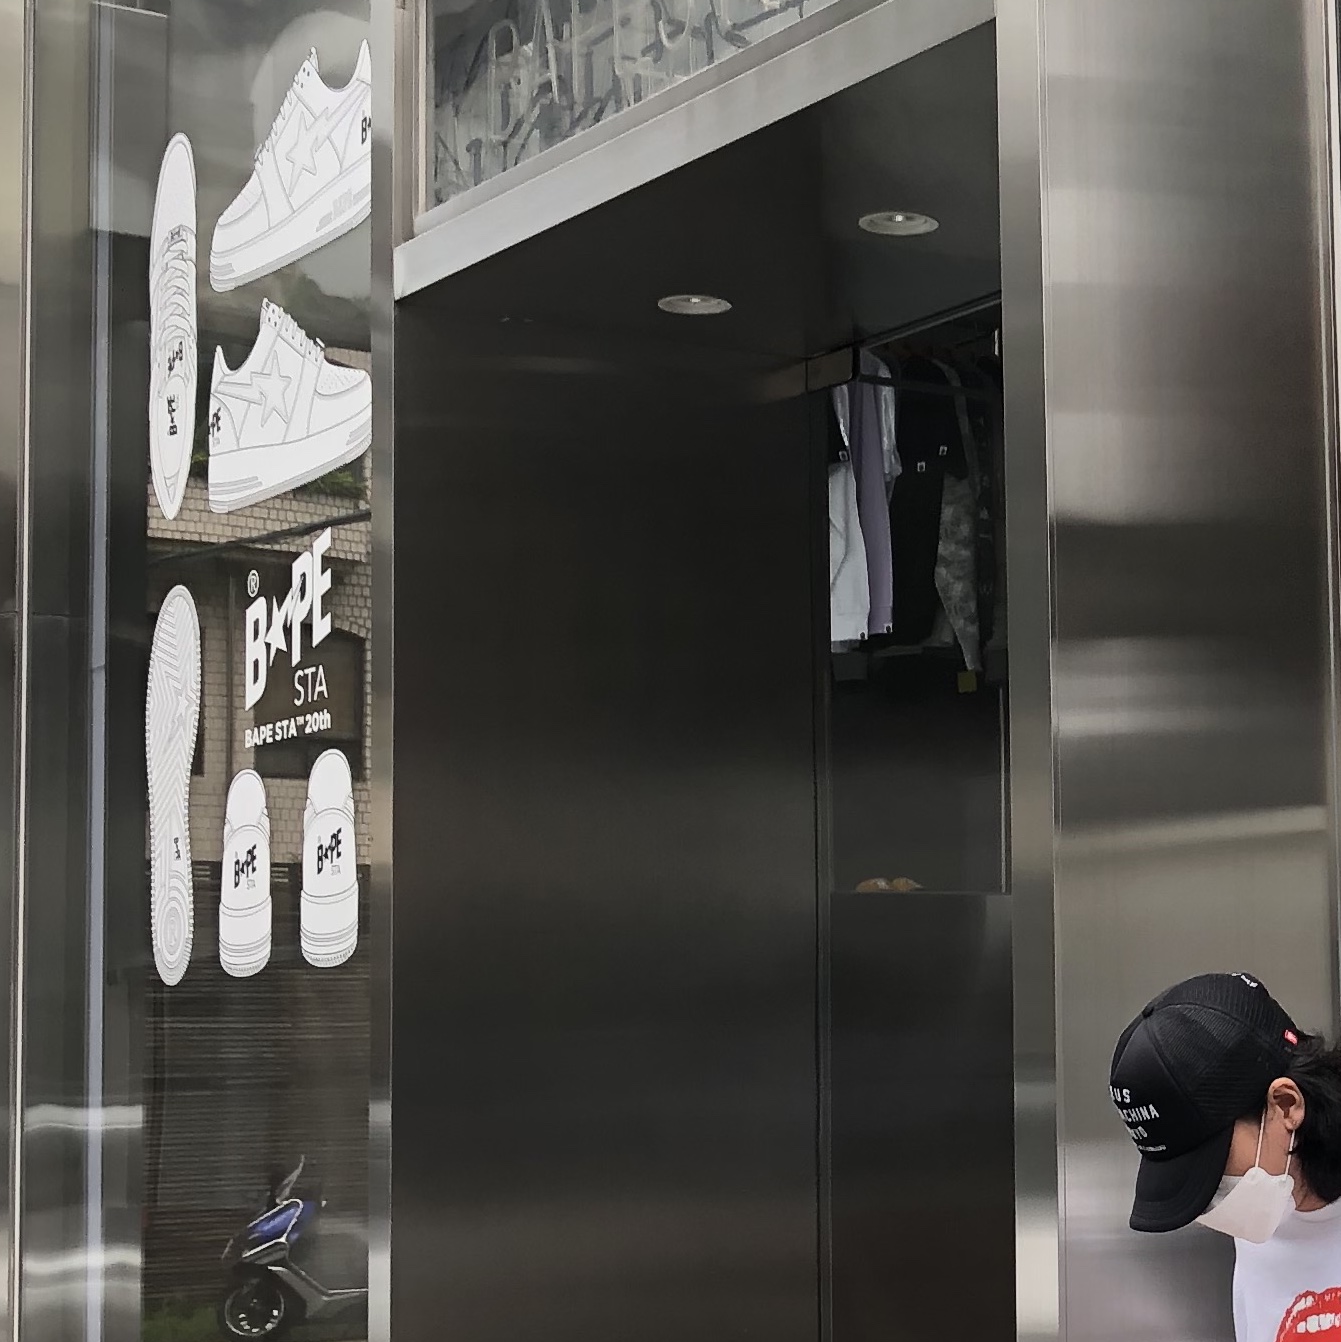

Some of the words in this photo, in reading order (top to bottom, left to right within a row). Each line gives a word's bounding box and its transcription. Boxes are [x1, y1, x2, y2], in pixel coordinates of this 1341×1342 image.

[293, 664, 328, 707] STA
[245, 724, 273, 749] BAPE
[304, 713, 332, 735] 20th
